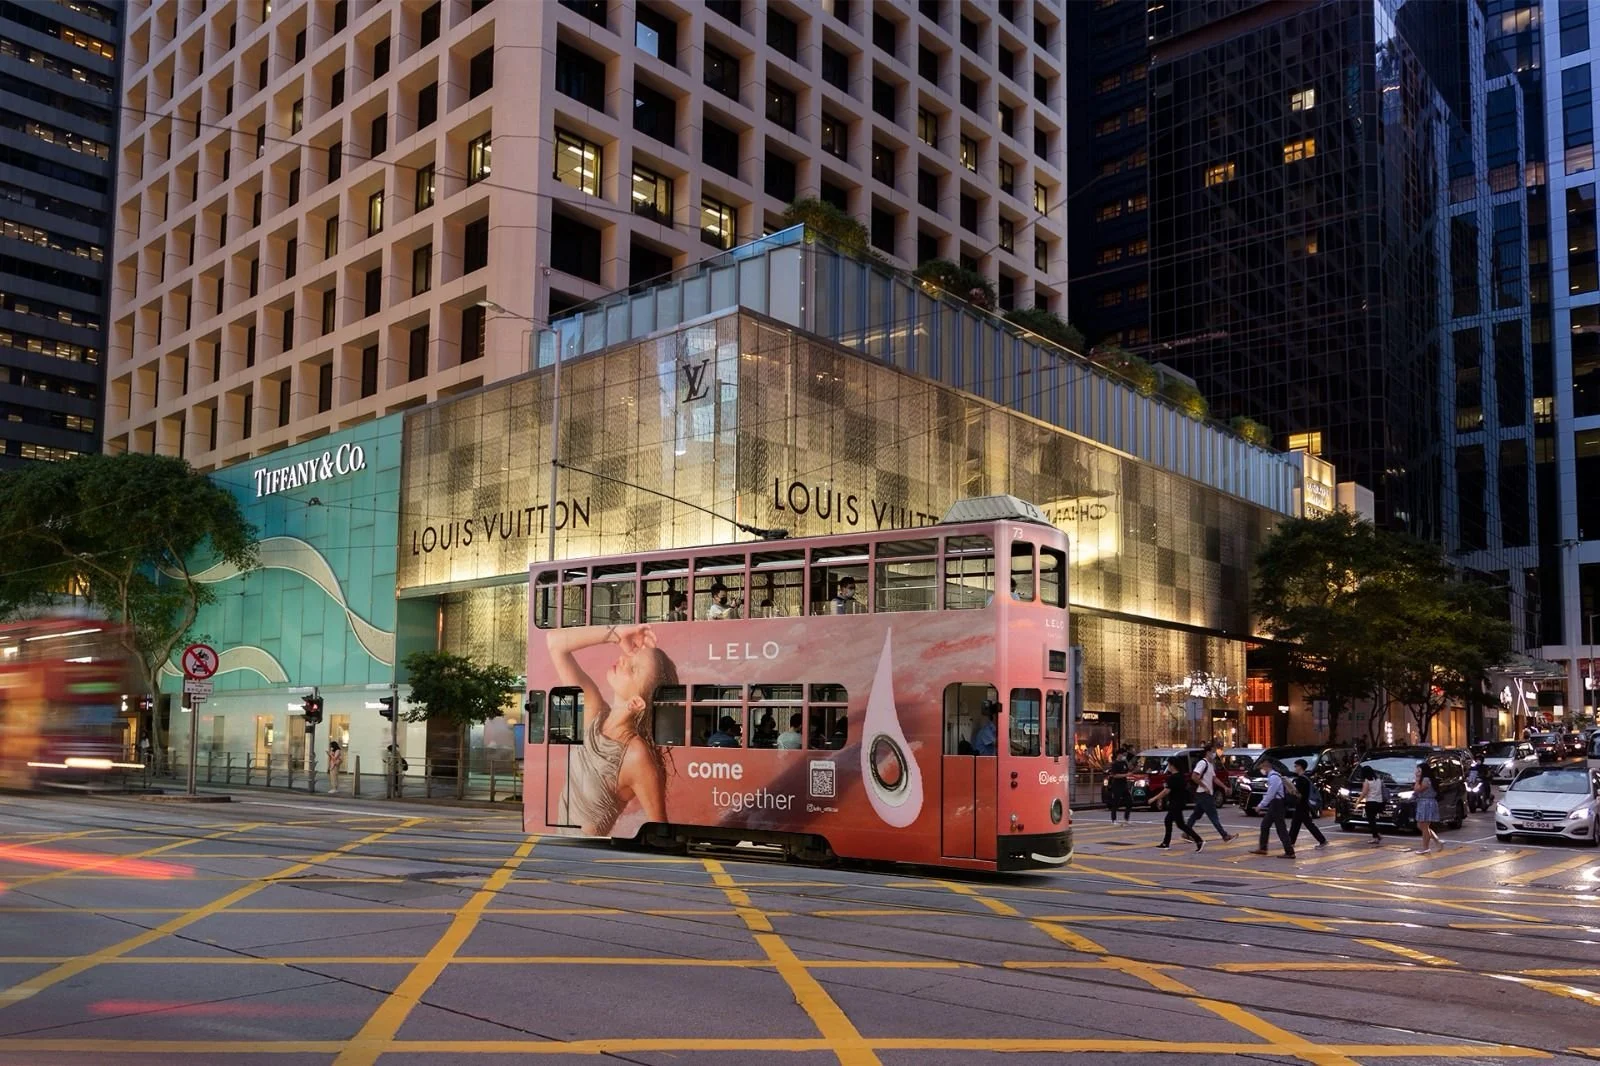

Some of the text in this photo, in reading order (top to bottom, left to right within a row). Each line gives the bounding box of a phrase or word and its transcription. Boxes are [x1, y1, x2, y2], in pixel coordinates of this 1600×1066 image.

[774, 477, 939, 530] LOUIS VUITT
[412, 496, 591, 556] LOUIS VUITTON
[1012, 527, 1024, 539] 73
[708, 641, 779, 660] LELO
[687, 761, 743, 780] come
[712, 786, 796, 812] together
